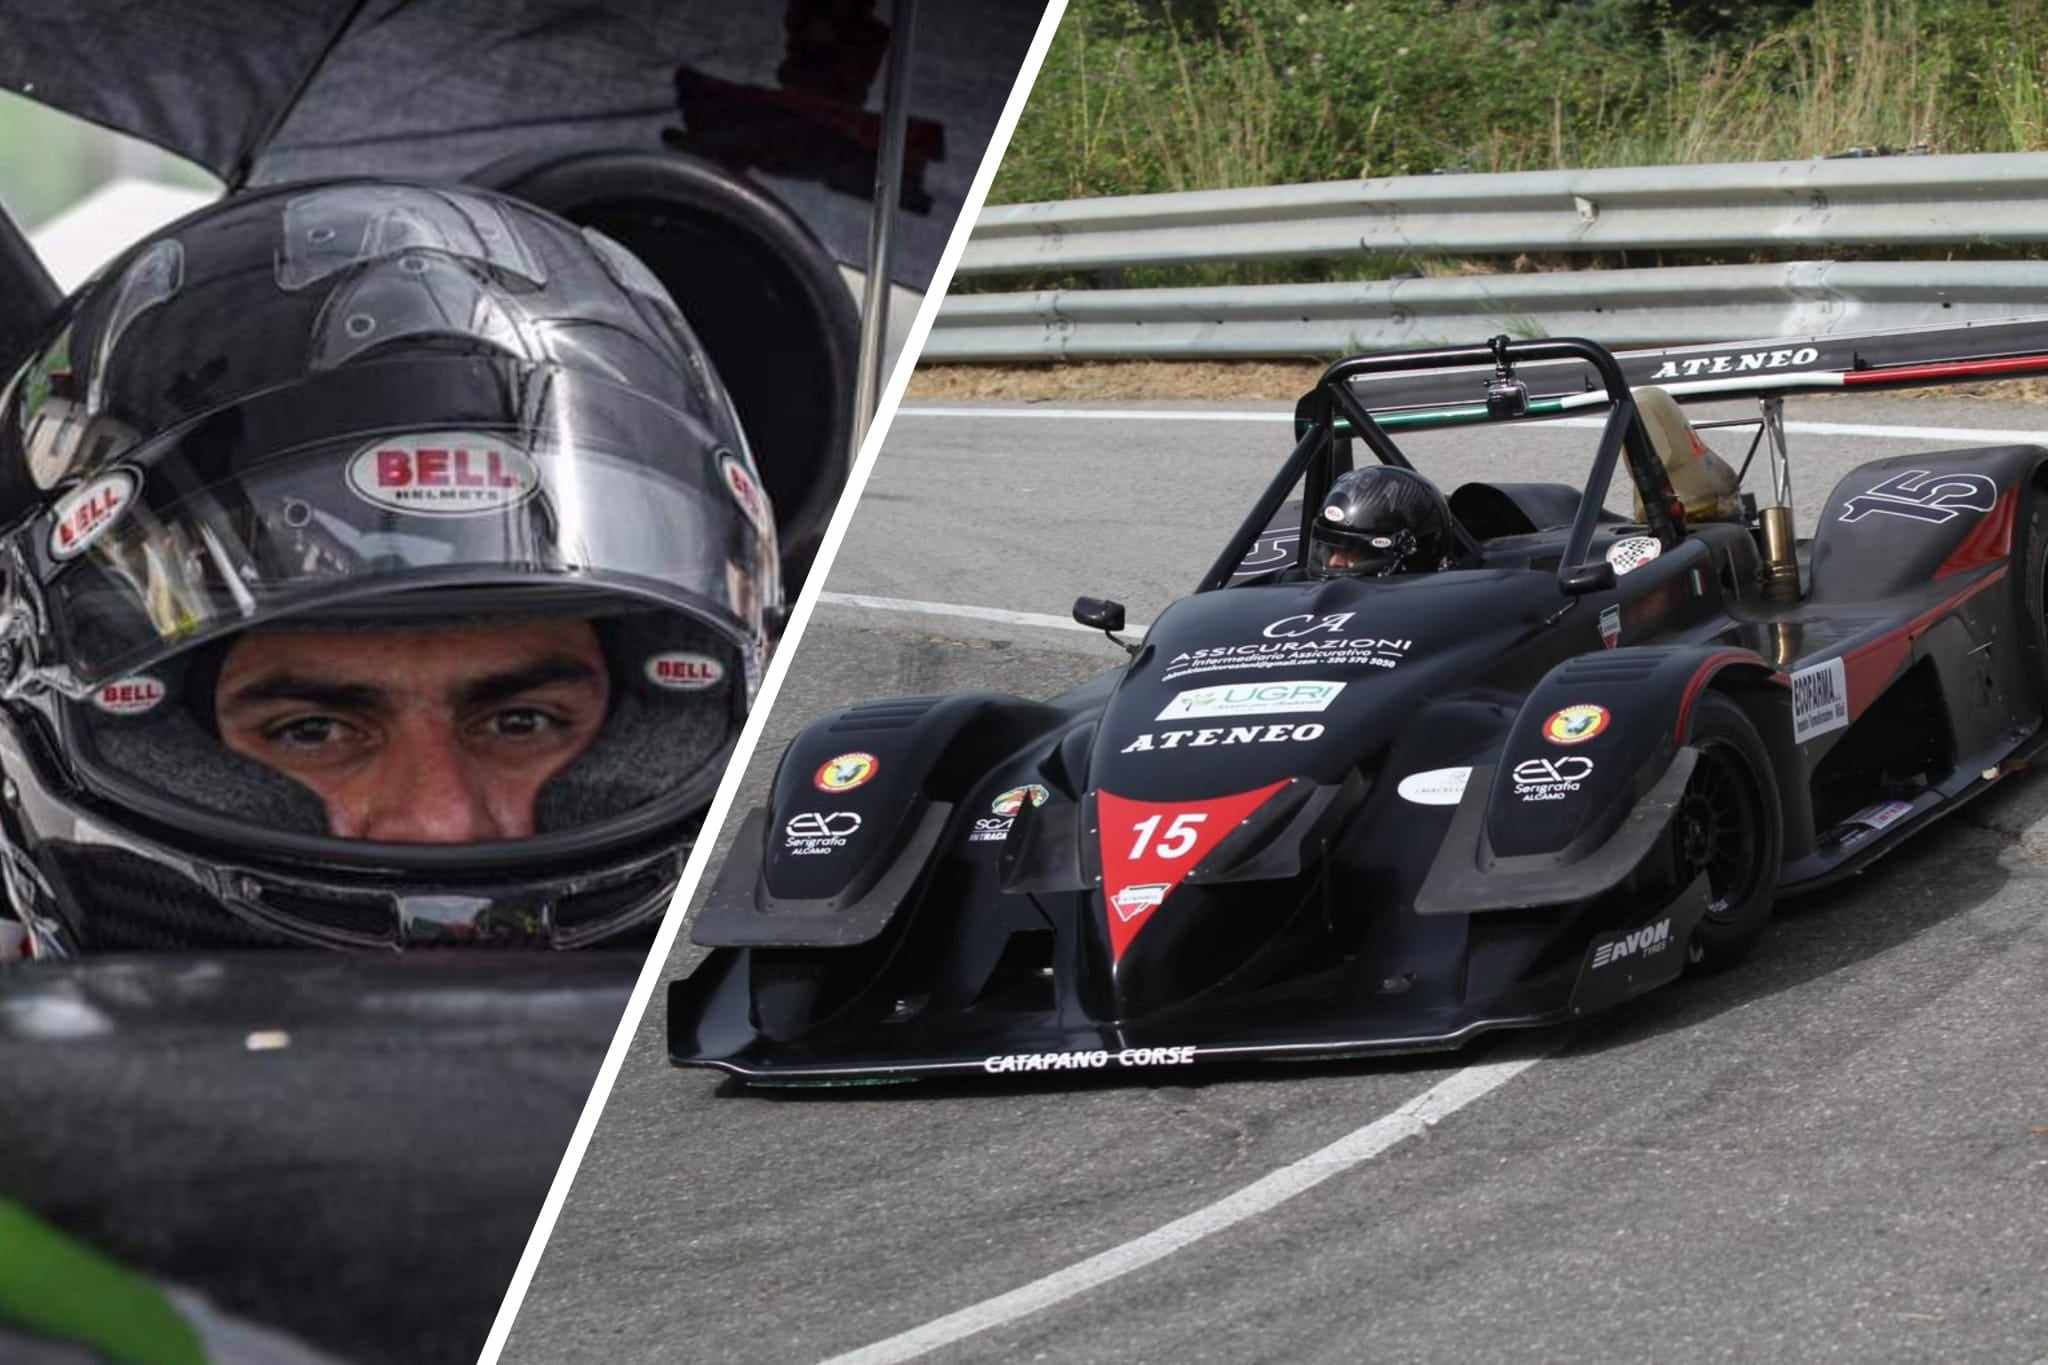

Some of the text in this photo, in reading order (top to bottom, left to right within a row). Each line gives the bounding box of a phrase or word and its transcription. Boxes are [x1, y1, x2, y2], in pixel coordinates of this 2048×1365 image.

[1650, 347, 1819, 379] ATENEO
[377, 449, 520, 488] BELL
[1838, 470, 1997, 524] 15
[1169, 639, 1412, 665] ASSICURAZIONI
[1191, 648, 1372, 668] Intermediario Assicurativo
[656, 660, 713, 679] BELL
[103, 683, 159, 702] BELL
[1120, 723, 1325, 753] ATENEO
[1513, 780, 1581, 795] Serigrafia
[1522, 792, 1566, 802] ALCAMO
[784, 836, 847, 849] Serigrafia
[1127, 813, 1208, 860] 15
[791, 846, 832, 855] ALCAMO
[1610, 918, 1671, 962] AVON
[984, 1046, 1197, 1073] CATAPANO CORSE
